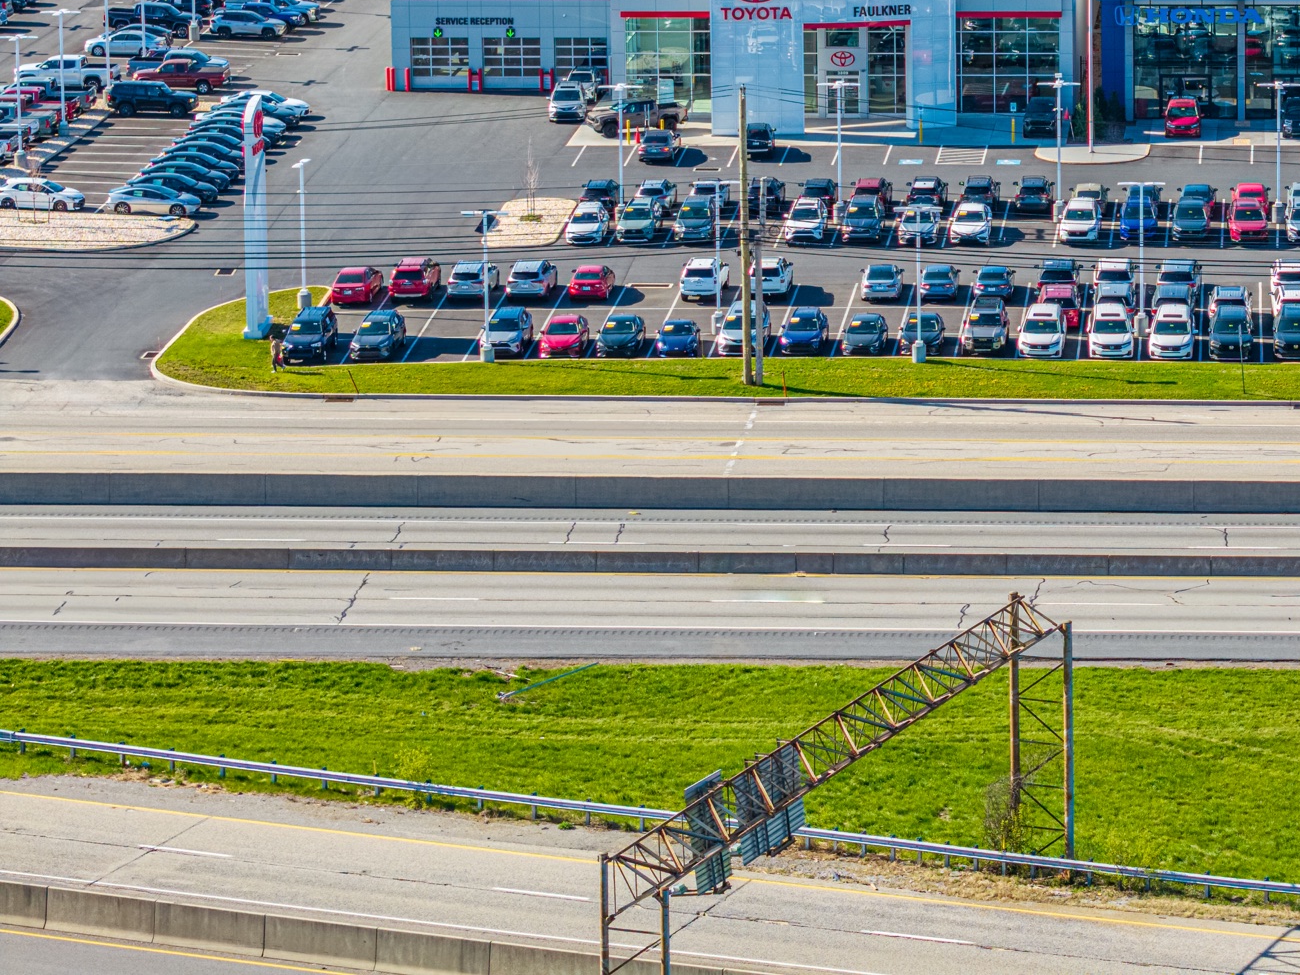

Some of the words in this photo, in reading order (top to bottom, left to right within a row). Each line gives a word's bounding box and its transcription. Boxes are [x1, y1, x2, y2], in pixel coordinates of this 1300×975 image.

[721, 7, 792, 20] TOYOTA
[853, 5, 911, 17] FAULKNER
[1144, 8, 1265, 24] HONDA
[435, 17, 468, 25] SERVICE
[470, 17, 514, 25] RECEPTION
